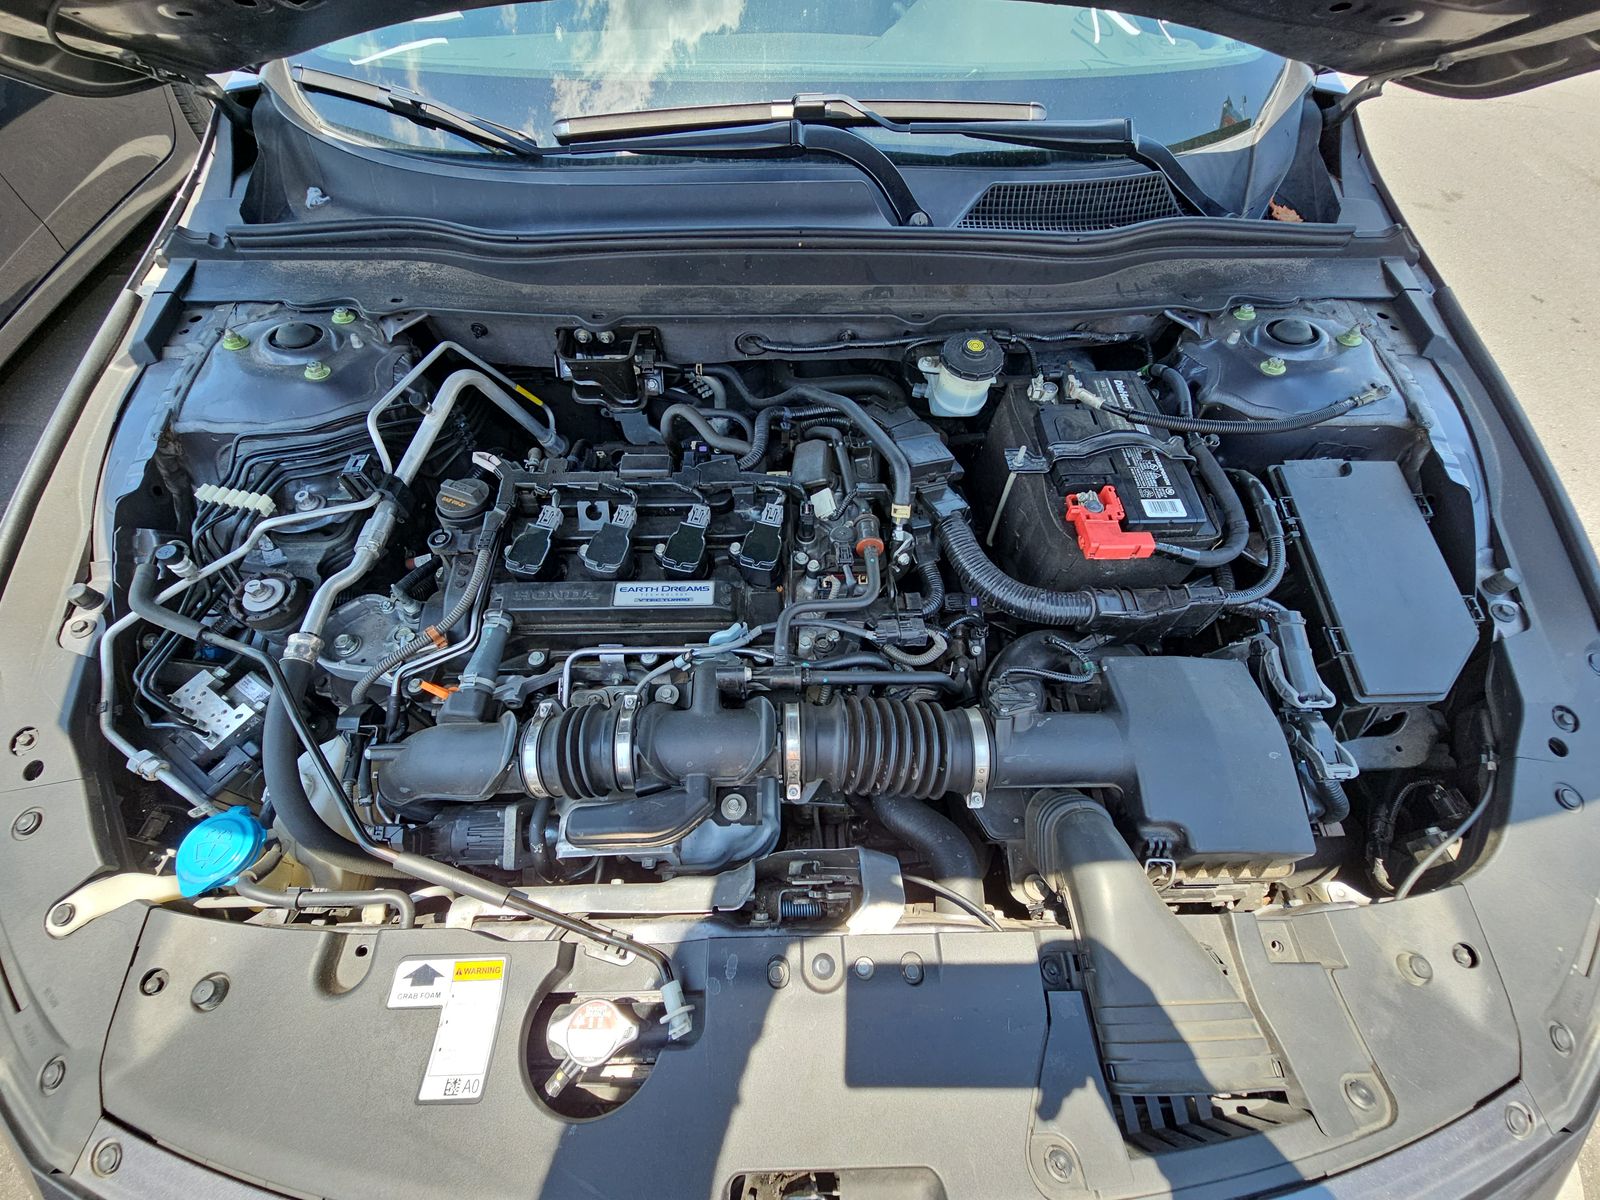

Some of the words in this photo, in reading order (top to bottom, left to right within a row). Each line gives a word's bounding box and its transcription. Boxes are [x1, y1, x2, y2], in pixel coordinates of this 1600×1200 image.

[1113, 379, 1134, 409] DieHard
[661, 585, 710, 593] DREAMS
[514, 590, 598, 601] HONDA
[463, 966, 501, 976] WARNING
[396, 992, 419, 1001] GRAB
[419, 991, 442, 1000] FOAM
[461, 1078, 480, 1094] A0
